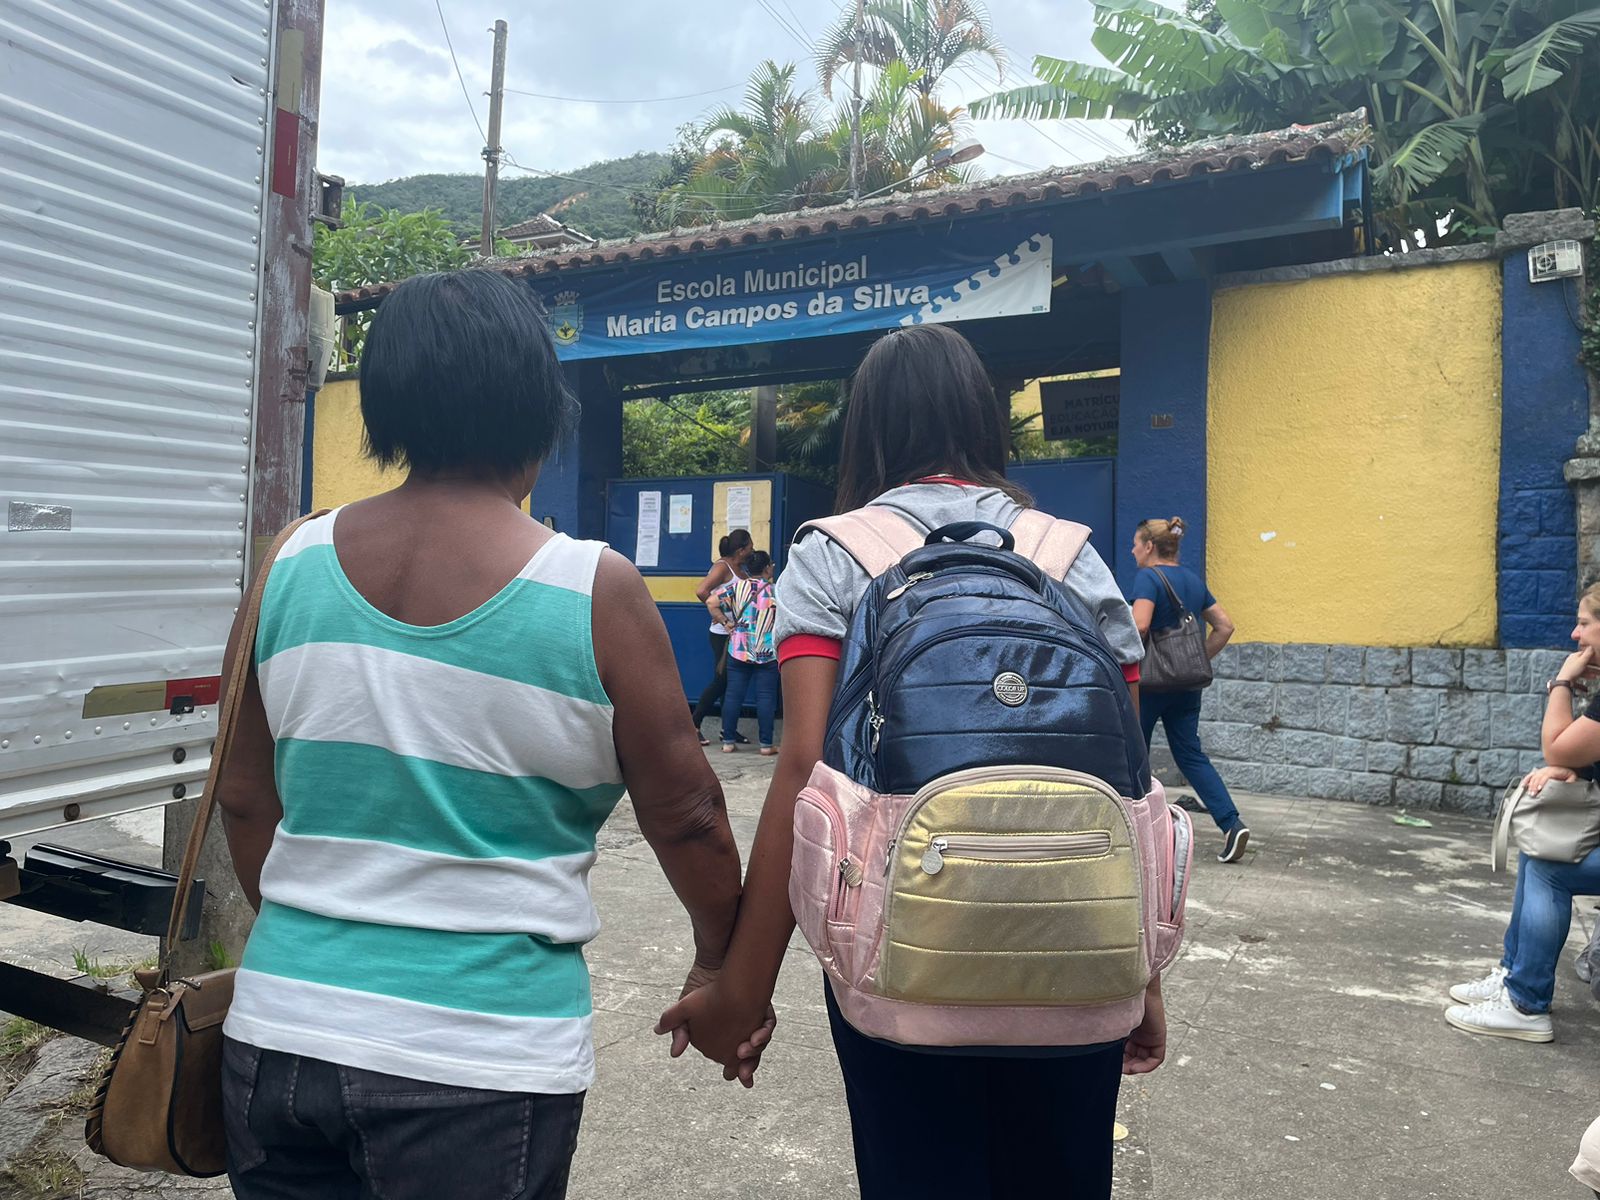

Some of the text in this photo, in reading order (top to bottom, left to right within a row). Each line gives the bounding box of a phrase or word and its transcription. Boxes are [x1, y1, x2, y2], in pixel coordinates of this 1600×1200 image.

[657, 254, 867, 303] Escola Municipal
[607, 283, 930, 338] Maria Campos da Silva
